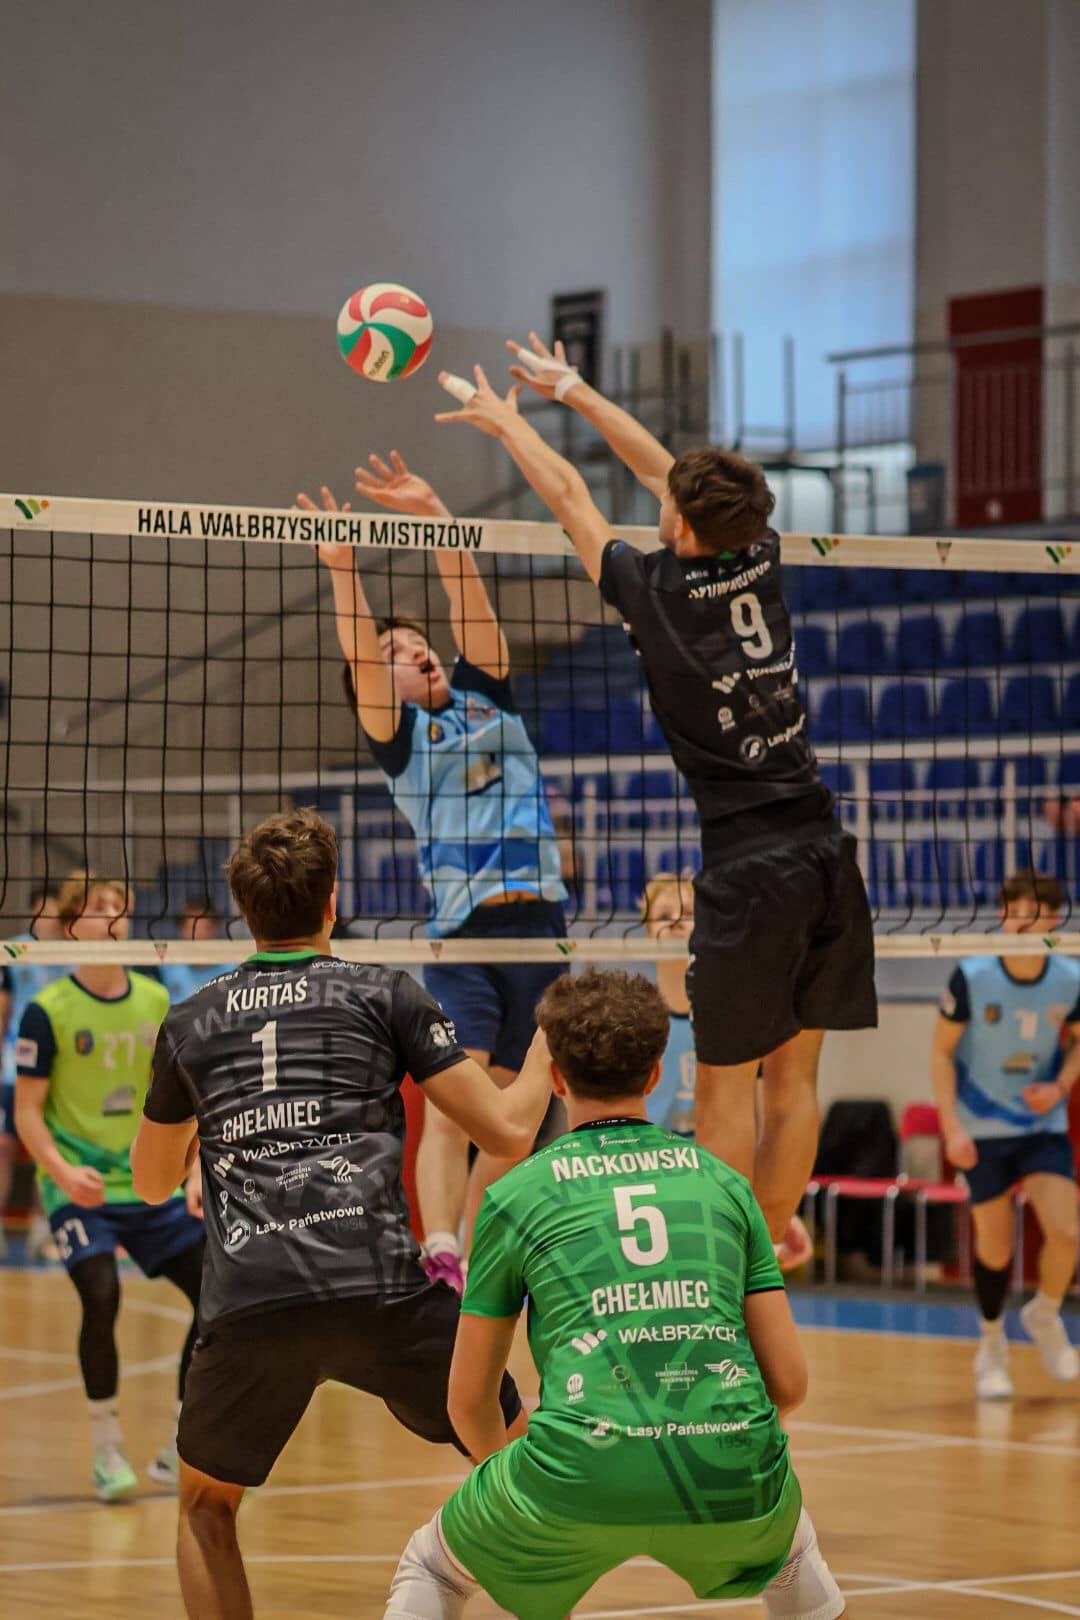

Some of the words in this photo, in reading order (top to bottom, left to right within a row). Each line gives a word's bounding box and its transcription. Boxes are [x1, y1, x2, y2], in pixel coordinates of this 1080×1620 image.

[138, 508, 192, 535] HALA
[200, 511, 361, 544] WAŁBRZYSKICH
[369, 519, 483, 549] MISTRZÓW
[730, 592, 773, 659] 9
[226, 976, 308, 1013] KURTAŚ
[102, 1031, 136, 1069] 27
[251, 1019, 277, 1092] 1
[222, 1100, 321, 1144] CHEŁMIEC
[551, 1147, 700, 1183] NACKOWSKI
[255, 1219, 286, 1236] Lasy
[288, 1204, 365, 1231] Państwowe
[613, 1183, 669, 1266] 5
[591, 1279, 710, 1317] CHEŁMIEC
[627, 1425, 662, 1440] Lasy
[667, 1418, 750, 1438] Państwowe
